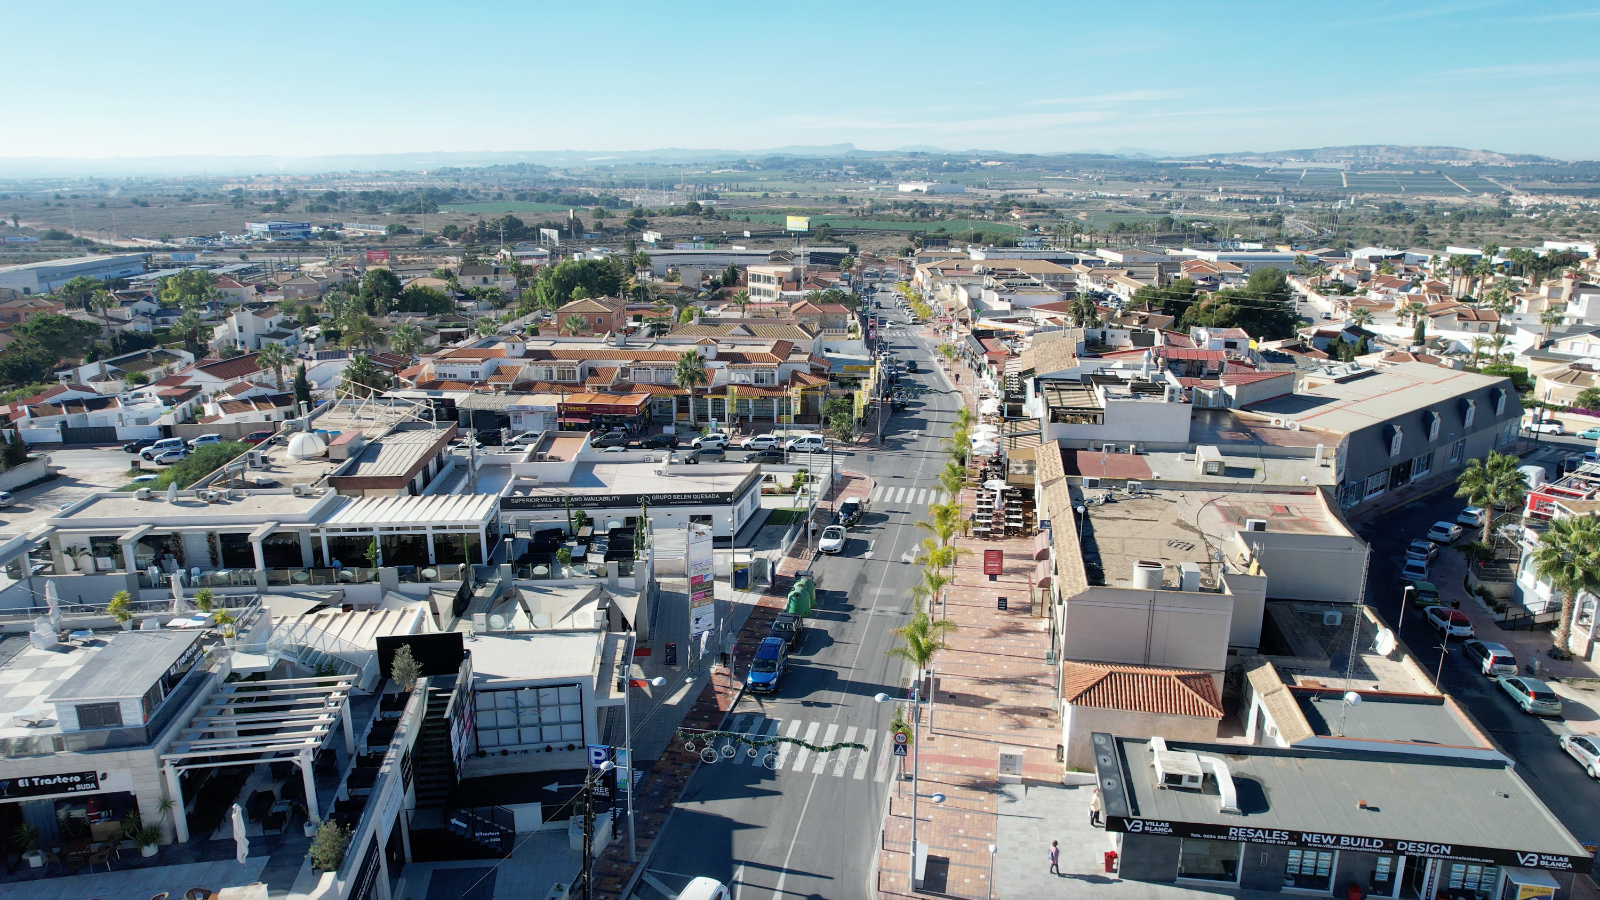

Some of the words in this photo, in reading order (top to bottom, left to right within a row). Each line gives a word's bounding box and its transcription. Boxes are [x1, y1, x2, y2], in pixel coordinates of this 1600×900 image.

[590, 748, 606, 764] P
[18, 778, 30, 788] El
[32, 775, 81, 786] Trastero
[76, 782, 96, 790] BUDA
[1228, 828, 1290, 840] RESALES
[1302, 833, 1337, 844] NEW
[1340, 836, 1384, 848] BUILD
[1396, 841, 1452, 854] DESIGN
